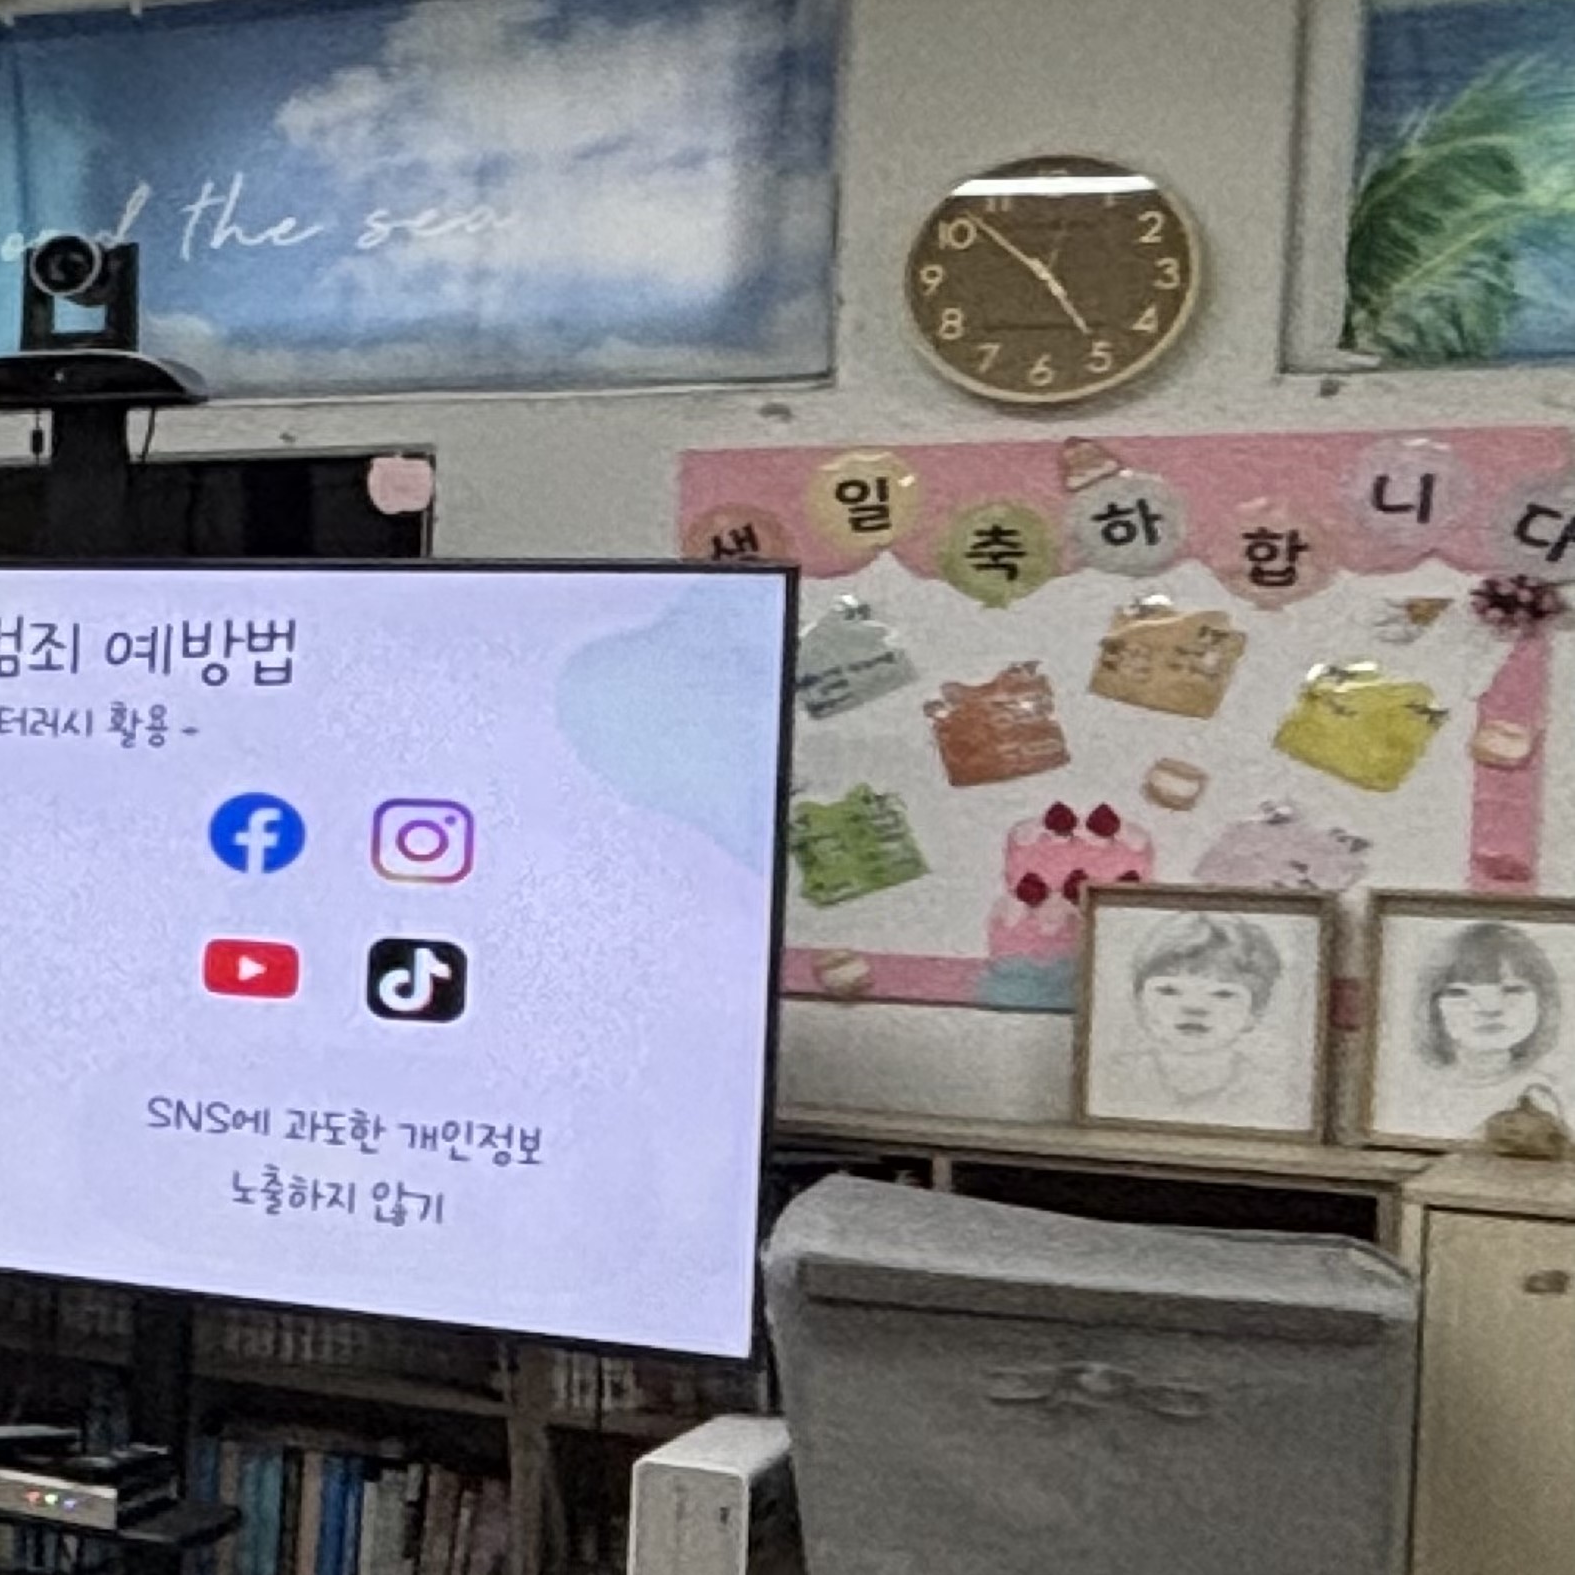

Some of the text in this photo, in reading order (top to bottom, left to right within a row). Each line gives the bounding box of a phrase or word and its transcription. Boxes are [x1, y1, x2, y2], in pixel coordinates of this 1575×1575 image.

[180, 171, 326, 262] the
[354, 202, 517, 251] sea
[1137, 210, 1166, 244] 2
[938, 217, 977, 250] 10
[918, 264, 945, 297] 9
[1153, 257, 1181, 290] 3
[937, 307, 966, 340] 8
[1130, 304, 1160, 334] 4
[976, 342, 1003, 373] 7
[1028, 354, 1056, 387] 6
[1084, 340, 1114, 374] 5
[104, 618, 298, 688] 예방법
[107, 701, 169, 749] 활용
[146, 1095, 544, 1168] SNS에 과도한 개인정보
[231, 1164, 446, 1228] 노출하지 않기
